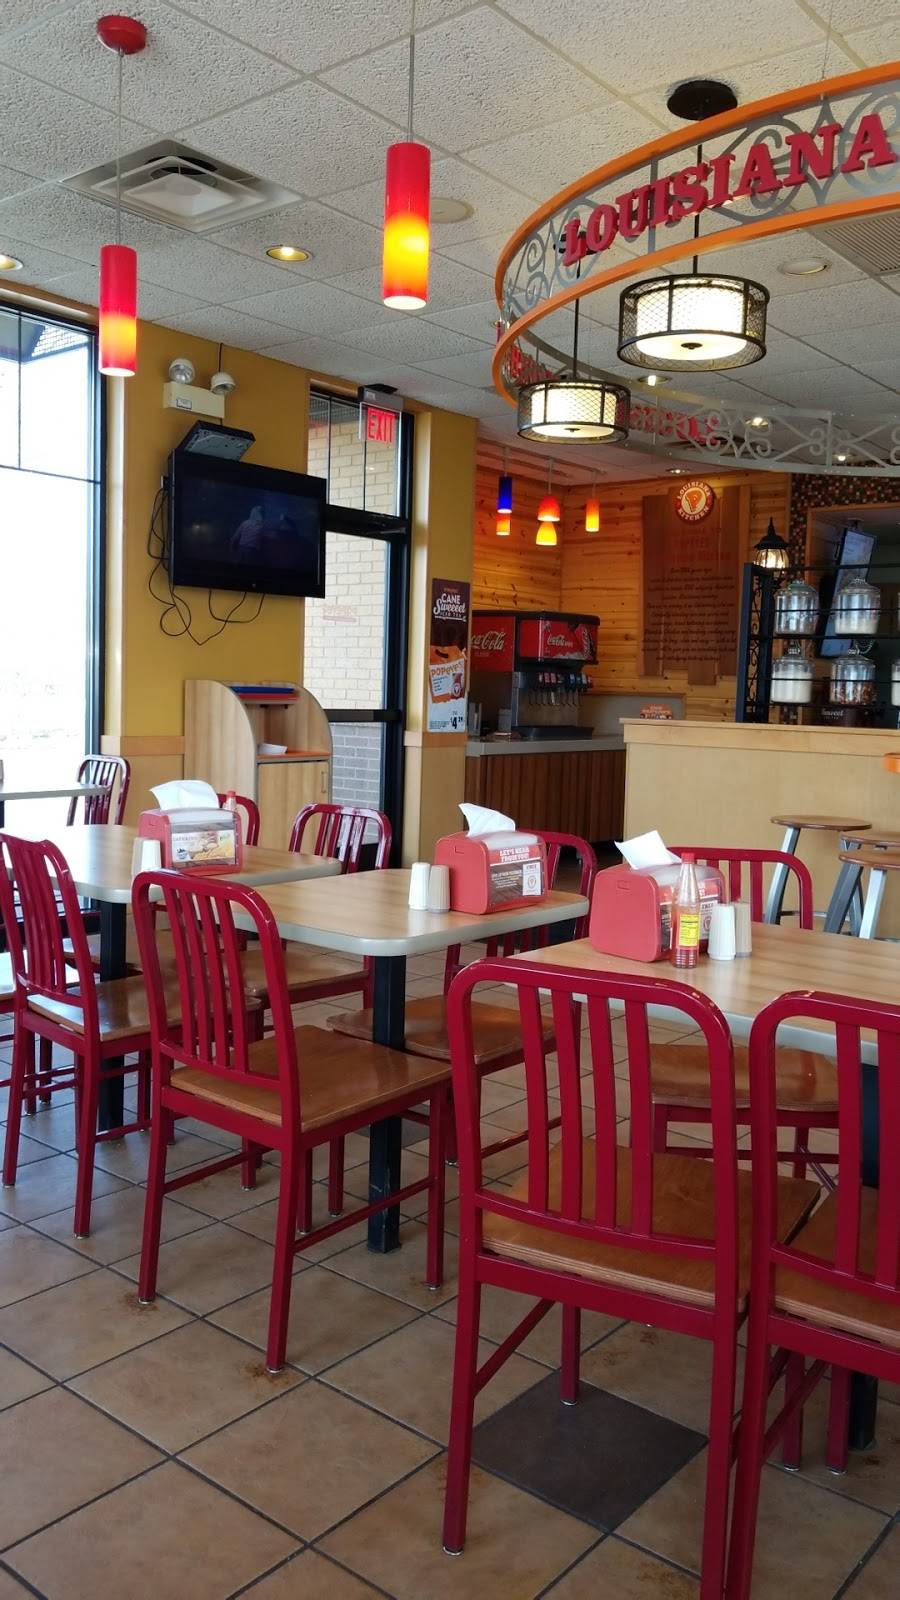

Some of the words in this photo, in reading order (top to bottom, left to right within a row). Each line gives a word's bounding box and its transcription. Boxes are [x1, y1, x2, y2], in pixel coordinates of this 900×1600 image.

[562, 112, 898, 267] LOUISIANA
[367, 407, 395, 443] EXIT
[677, 481, 713, 499] LOUISIANA
[678, 505, 710, 521] KITCHEN
[441, 593, 461, 604] CANE
